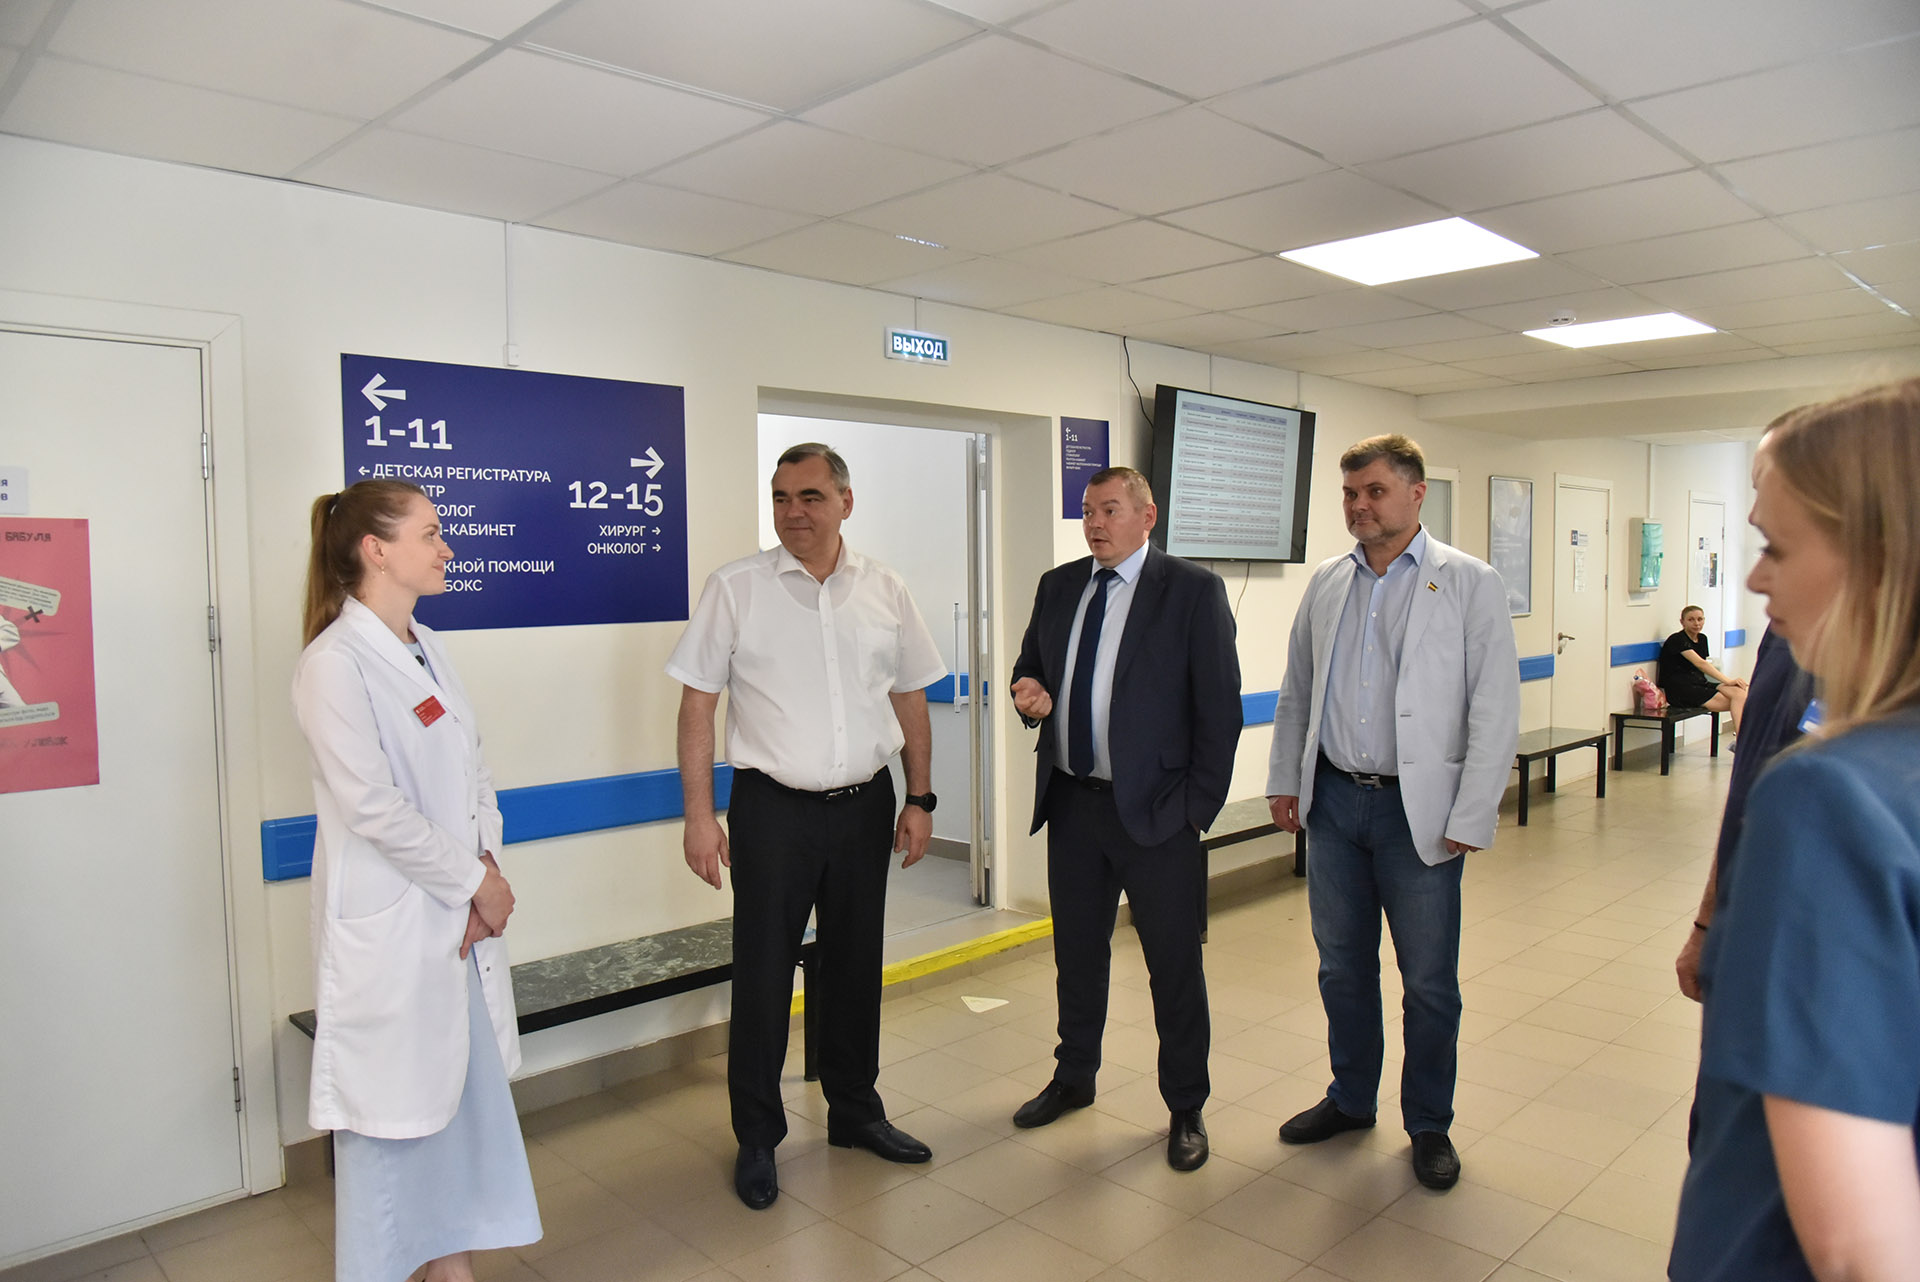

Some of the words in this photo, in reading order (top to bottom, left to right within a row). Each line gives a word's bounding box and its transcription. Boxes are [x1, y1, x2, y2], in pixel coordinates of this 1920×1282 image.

[893, 335, 944, 359] ВЫХОД
[365, 415, 452, 450] 1-11
[1065, 433, 1078, 442] 1-11
[373, 464, 443, 479] ДЕТСКАЯ
[447, 467, 551, 483] РЕГИСТРАТУРА
[568, 480, 664, 517] 12-15
[599, 525, 646, 537] ХИРУРГ
[587, 542, 647, 554] ОНКОЛОГ
[488, 560, 555, 575] ПОМОЩИ
